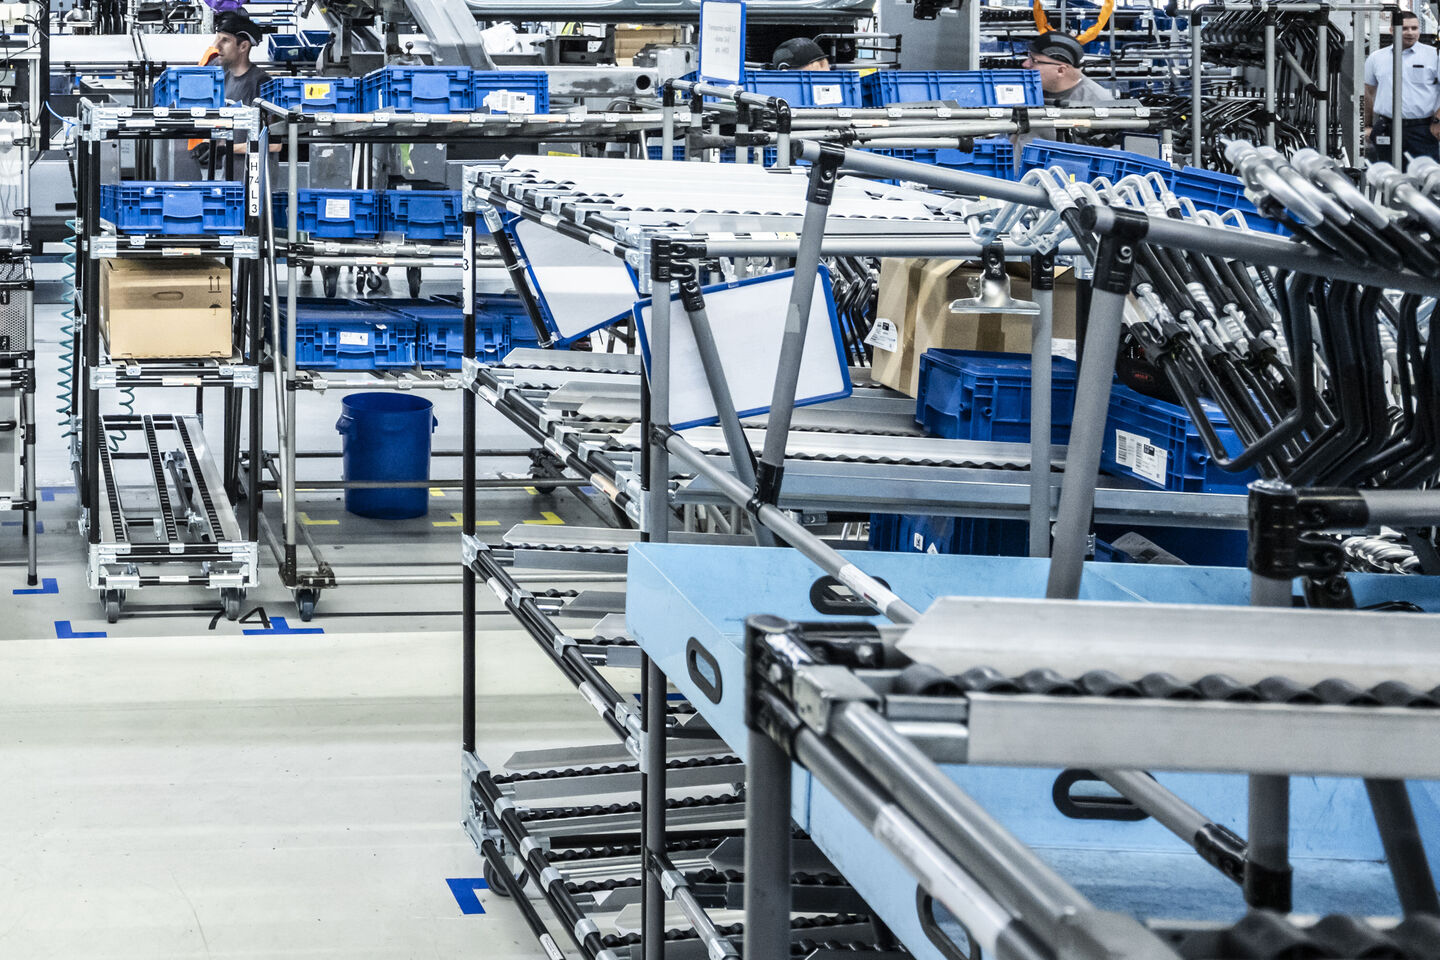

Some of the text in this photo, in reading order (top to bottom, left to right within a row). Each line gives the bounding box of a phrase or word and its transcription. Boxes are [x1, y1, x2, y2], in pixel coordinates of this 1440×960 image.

[251, 162, 258, 171] H
[252, 191, 258, 199] L
[252, 204, 258, 213] 3
